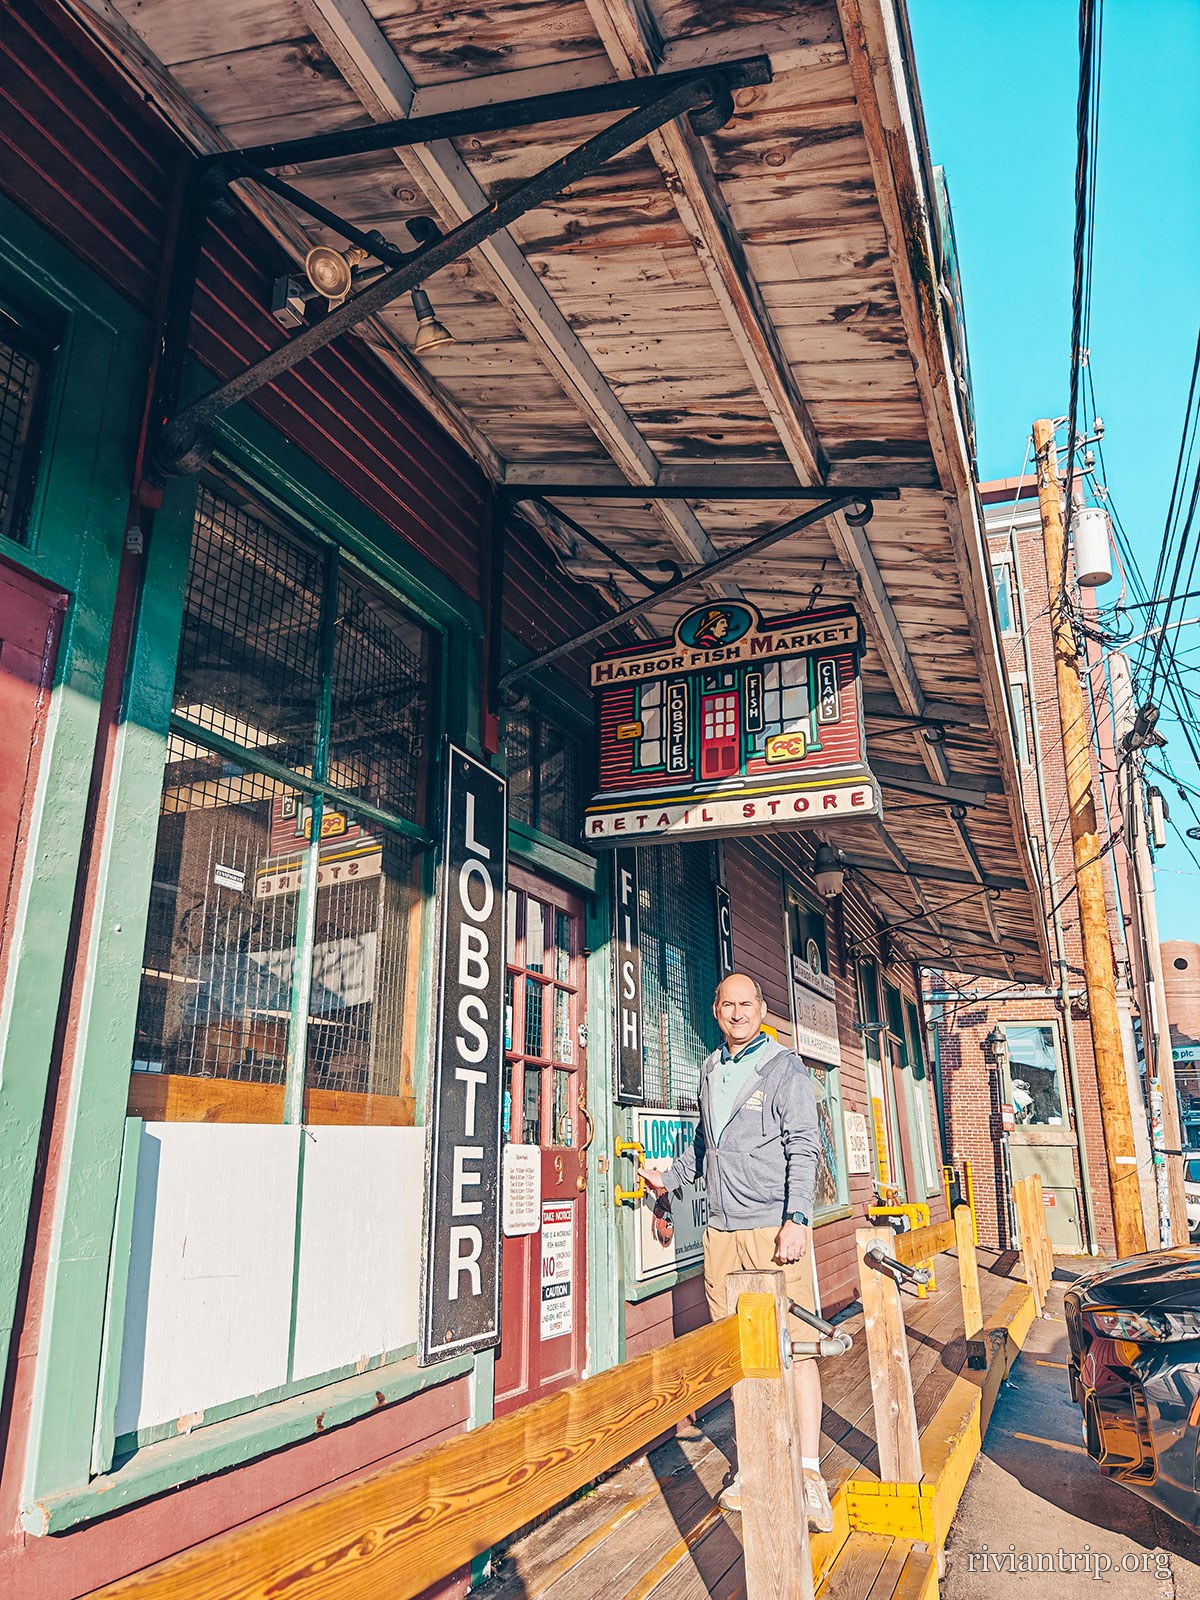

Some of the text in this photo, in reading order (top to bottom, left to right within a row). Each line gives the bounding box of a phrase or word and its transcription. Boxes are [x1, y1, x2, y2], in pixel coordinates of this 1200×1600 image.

[595, 627, 853, 684] HARBOR FISH MARKET
[749, 679, 758, 718] FISH
[822, 665, 833, 716] CLAMS
[672, 686, 684, 768] LOBSTER
[592, 791, 864, 833] RETAIL STORE
[621, 868, 637, 1050] FISH
[448, 791, 494, 1301] LOBSTER
[543, 1210, 571, 1222] TAKE NOTICE
[543, 1256, 555, 1278] NO
[545, 1284, 568, 1298] CAUTION
